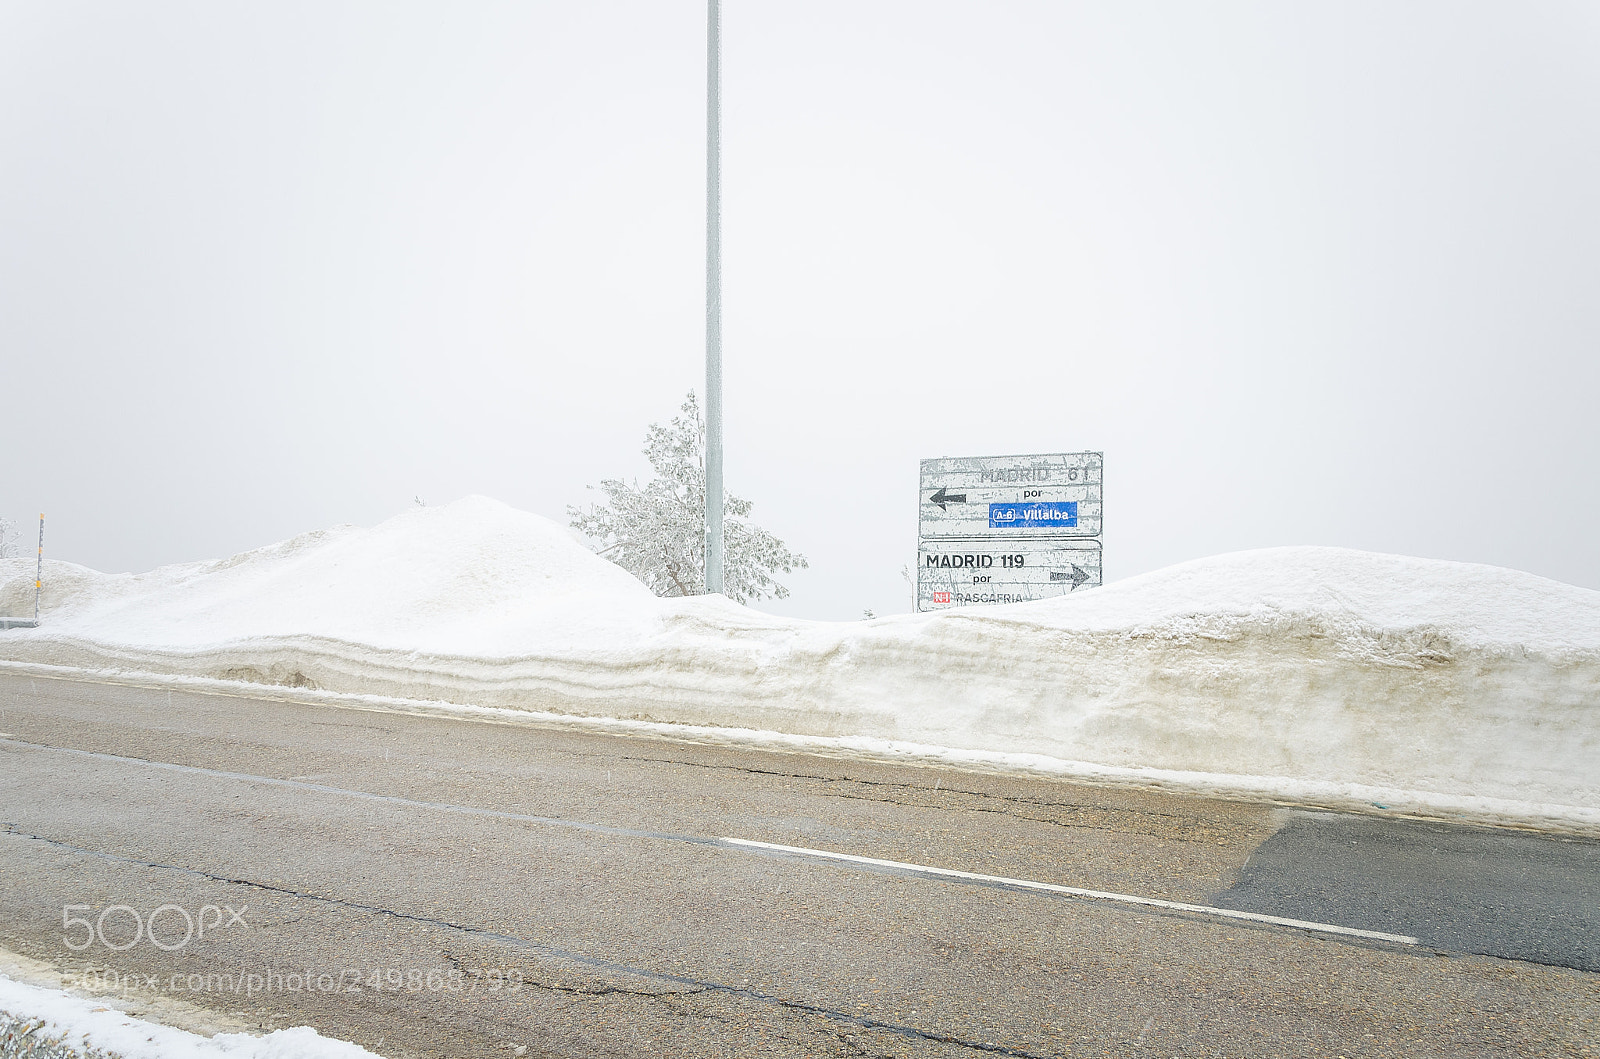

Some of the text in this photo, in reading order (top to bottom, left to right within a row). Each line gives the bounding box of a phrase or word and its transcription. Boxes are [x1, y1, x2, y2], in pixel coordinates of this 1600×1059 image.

[980, 466, 1089, 482] MADRID 61
[1023, 490, 1042, 499] por
[996, 509, 1069, 520] A-6 Villalba
[926, 554, 1025, 569] MADRID 119
[973, 575, 992, 586] por
